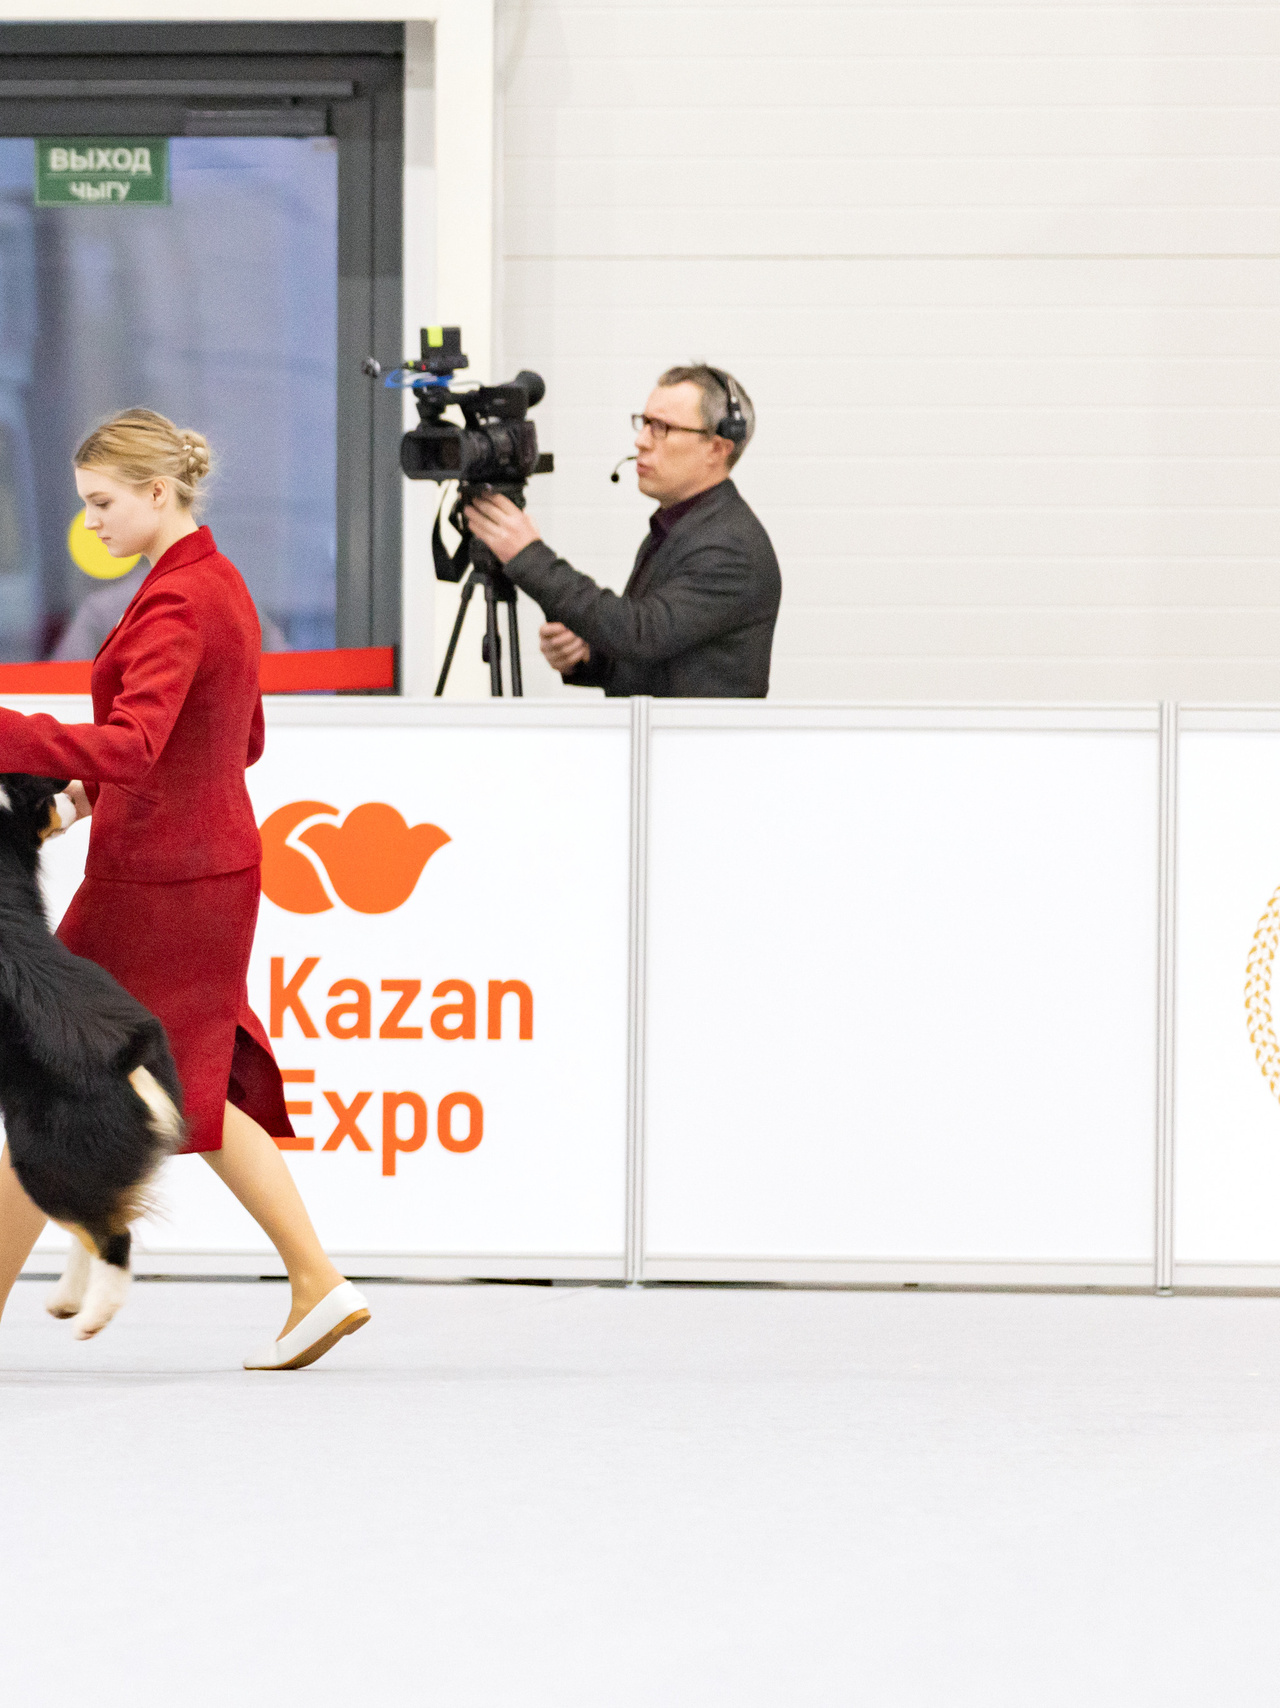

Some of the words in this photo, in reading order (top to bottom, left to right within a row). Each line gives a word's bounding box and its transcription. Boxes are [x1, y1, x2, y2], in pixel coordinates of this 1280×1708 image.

[48, 147, 152, 176] ВЫХОД
[68, 181, 131, 202] ЧЫГУ
[269, 956, 534, 1041] Kazan
[272, 1069, 484, 1177] Expo
